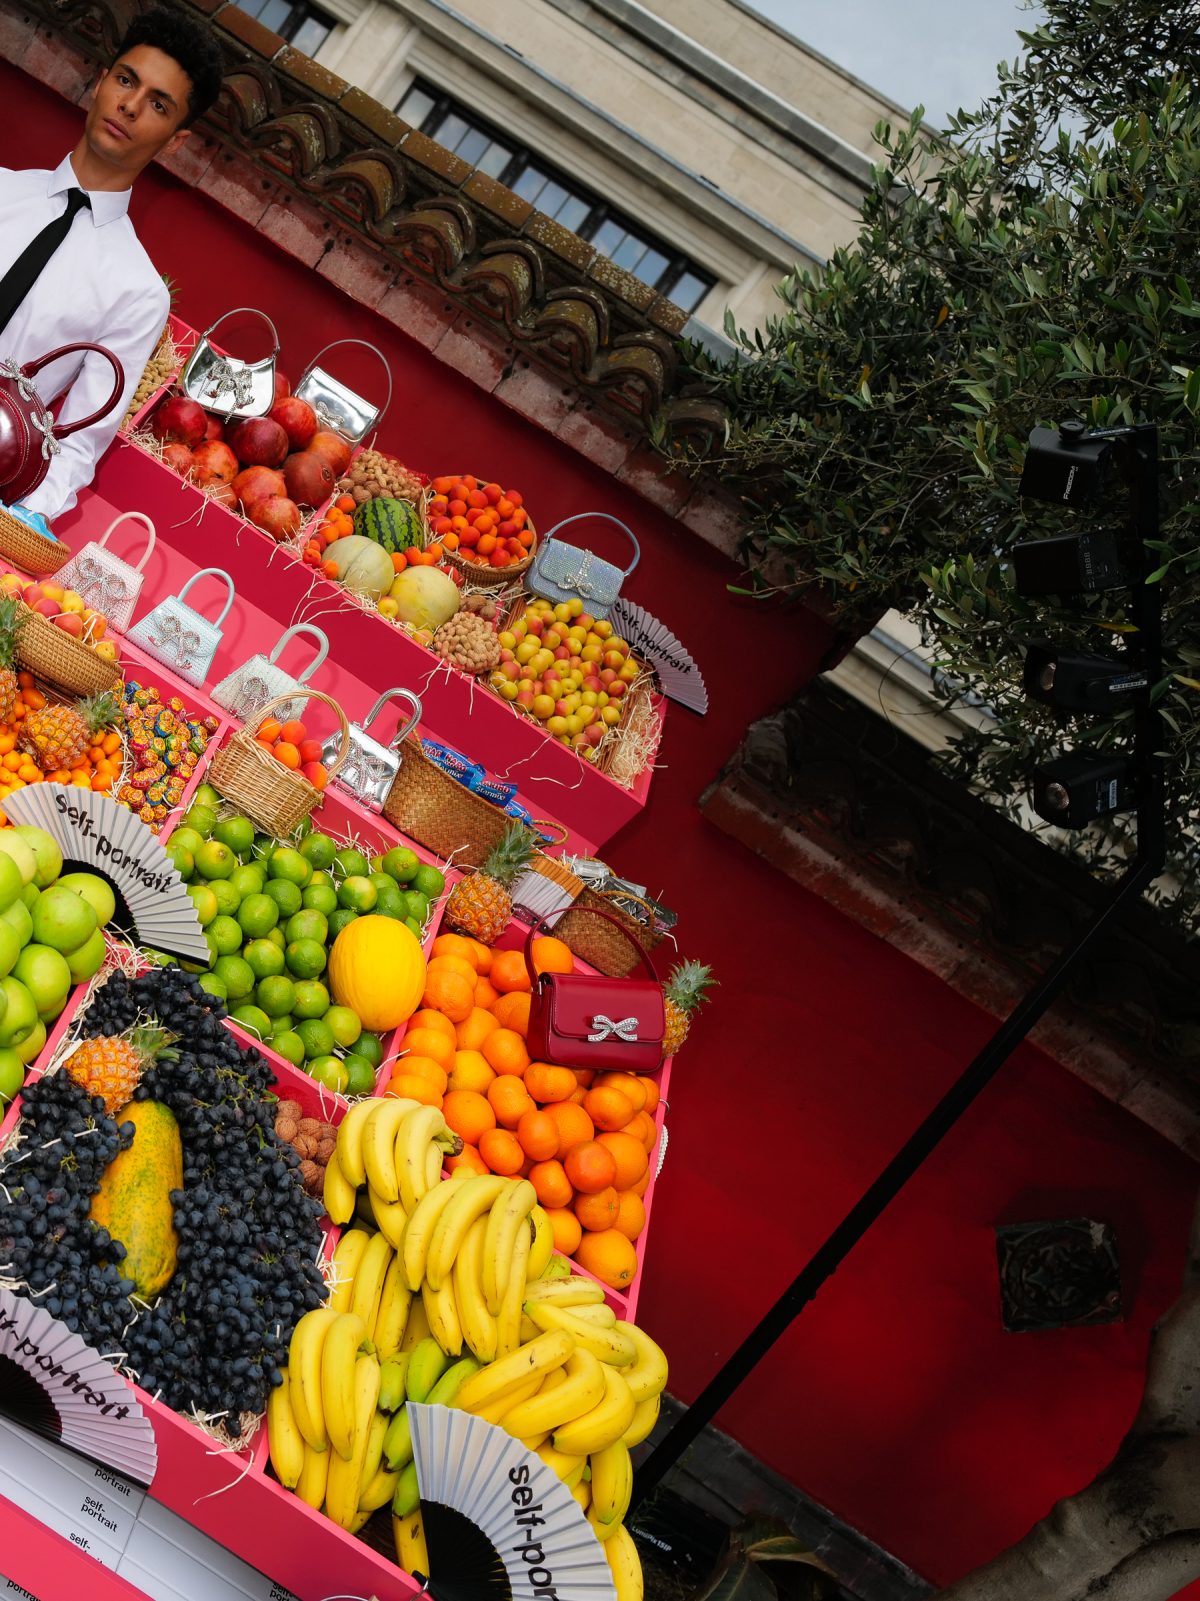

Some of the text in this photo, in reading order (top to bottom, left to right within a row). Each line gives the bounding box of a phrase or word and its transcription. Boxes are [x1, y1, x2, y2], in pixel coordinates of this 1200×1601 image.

[614, 601, 692, 674] self-portrait
[55, 793, 173, 894] self-portrait
[94, 1467, 132, 1496] portrait
[80, 1503, 118, 1532] portrait
[84, 1496, 106, 1513] self-
[69, 1532, 91, 1550] self-
[508, 1464, 560, 1601] self-por
